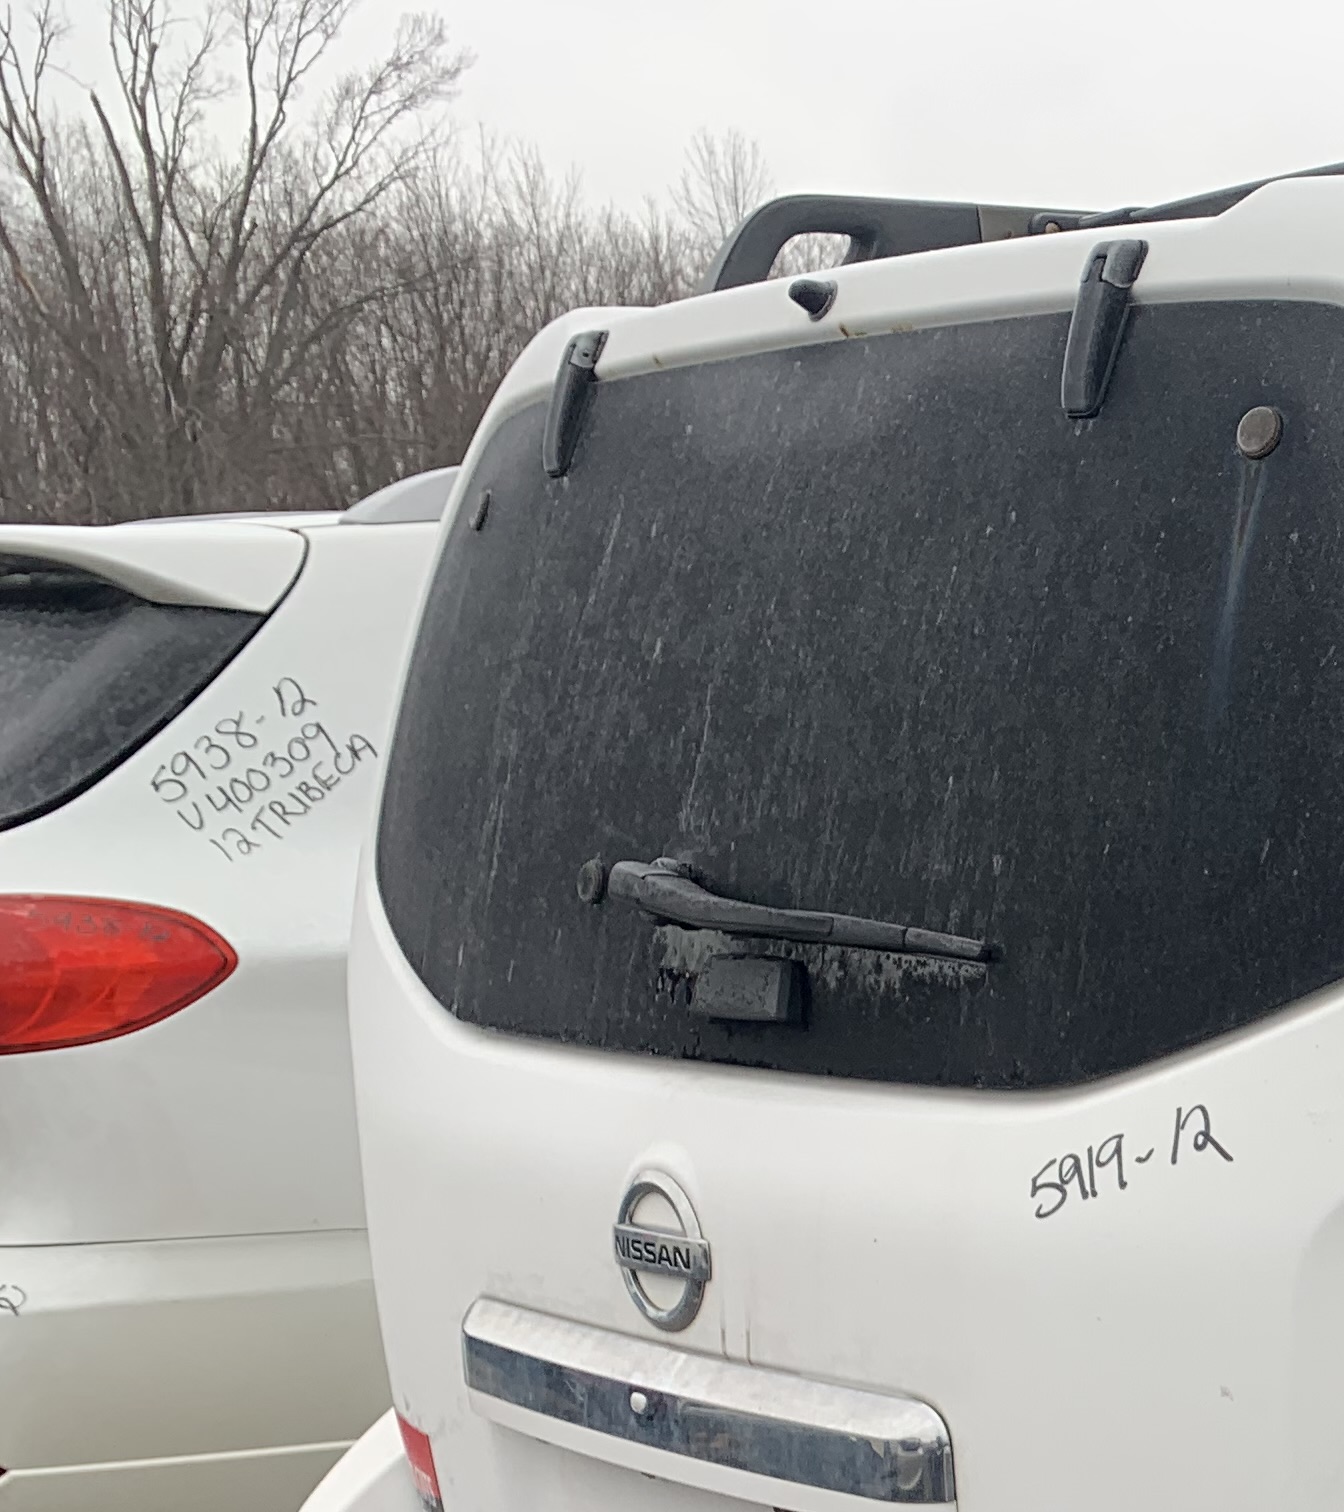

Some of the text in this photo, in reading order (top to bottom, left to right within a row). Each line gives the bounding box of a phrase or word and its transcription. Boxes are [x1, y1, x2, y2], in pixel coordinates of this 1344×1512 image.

[150, 677, 318, 803] 5938-12
[1030, 1104, 1234, 1219] 5919-12
[615, 1235, 691, 1270] NISSAN
